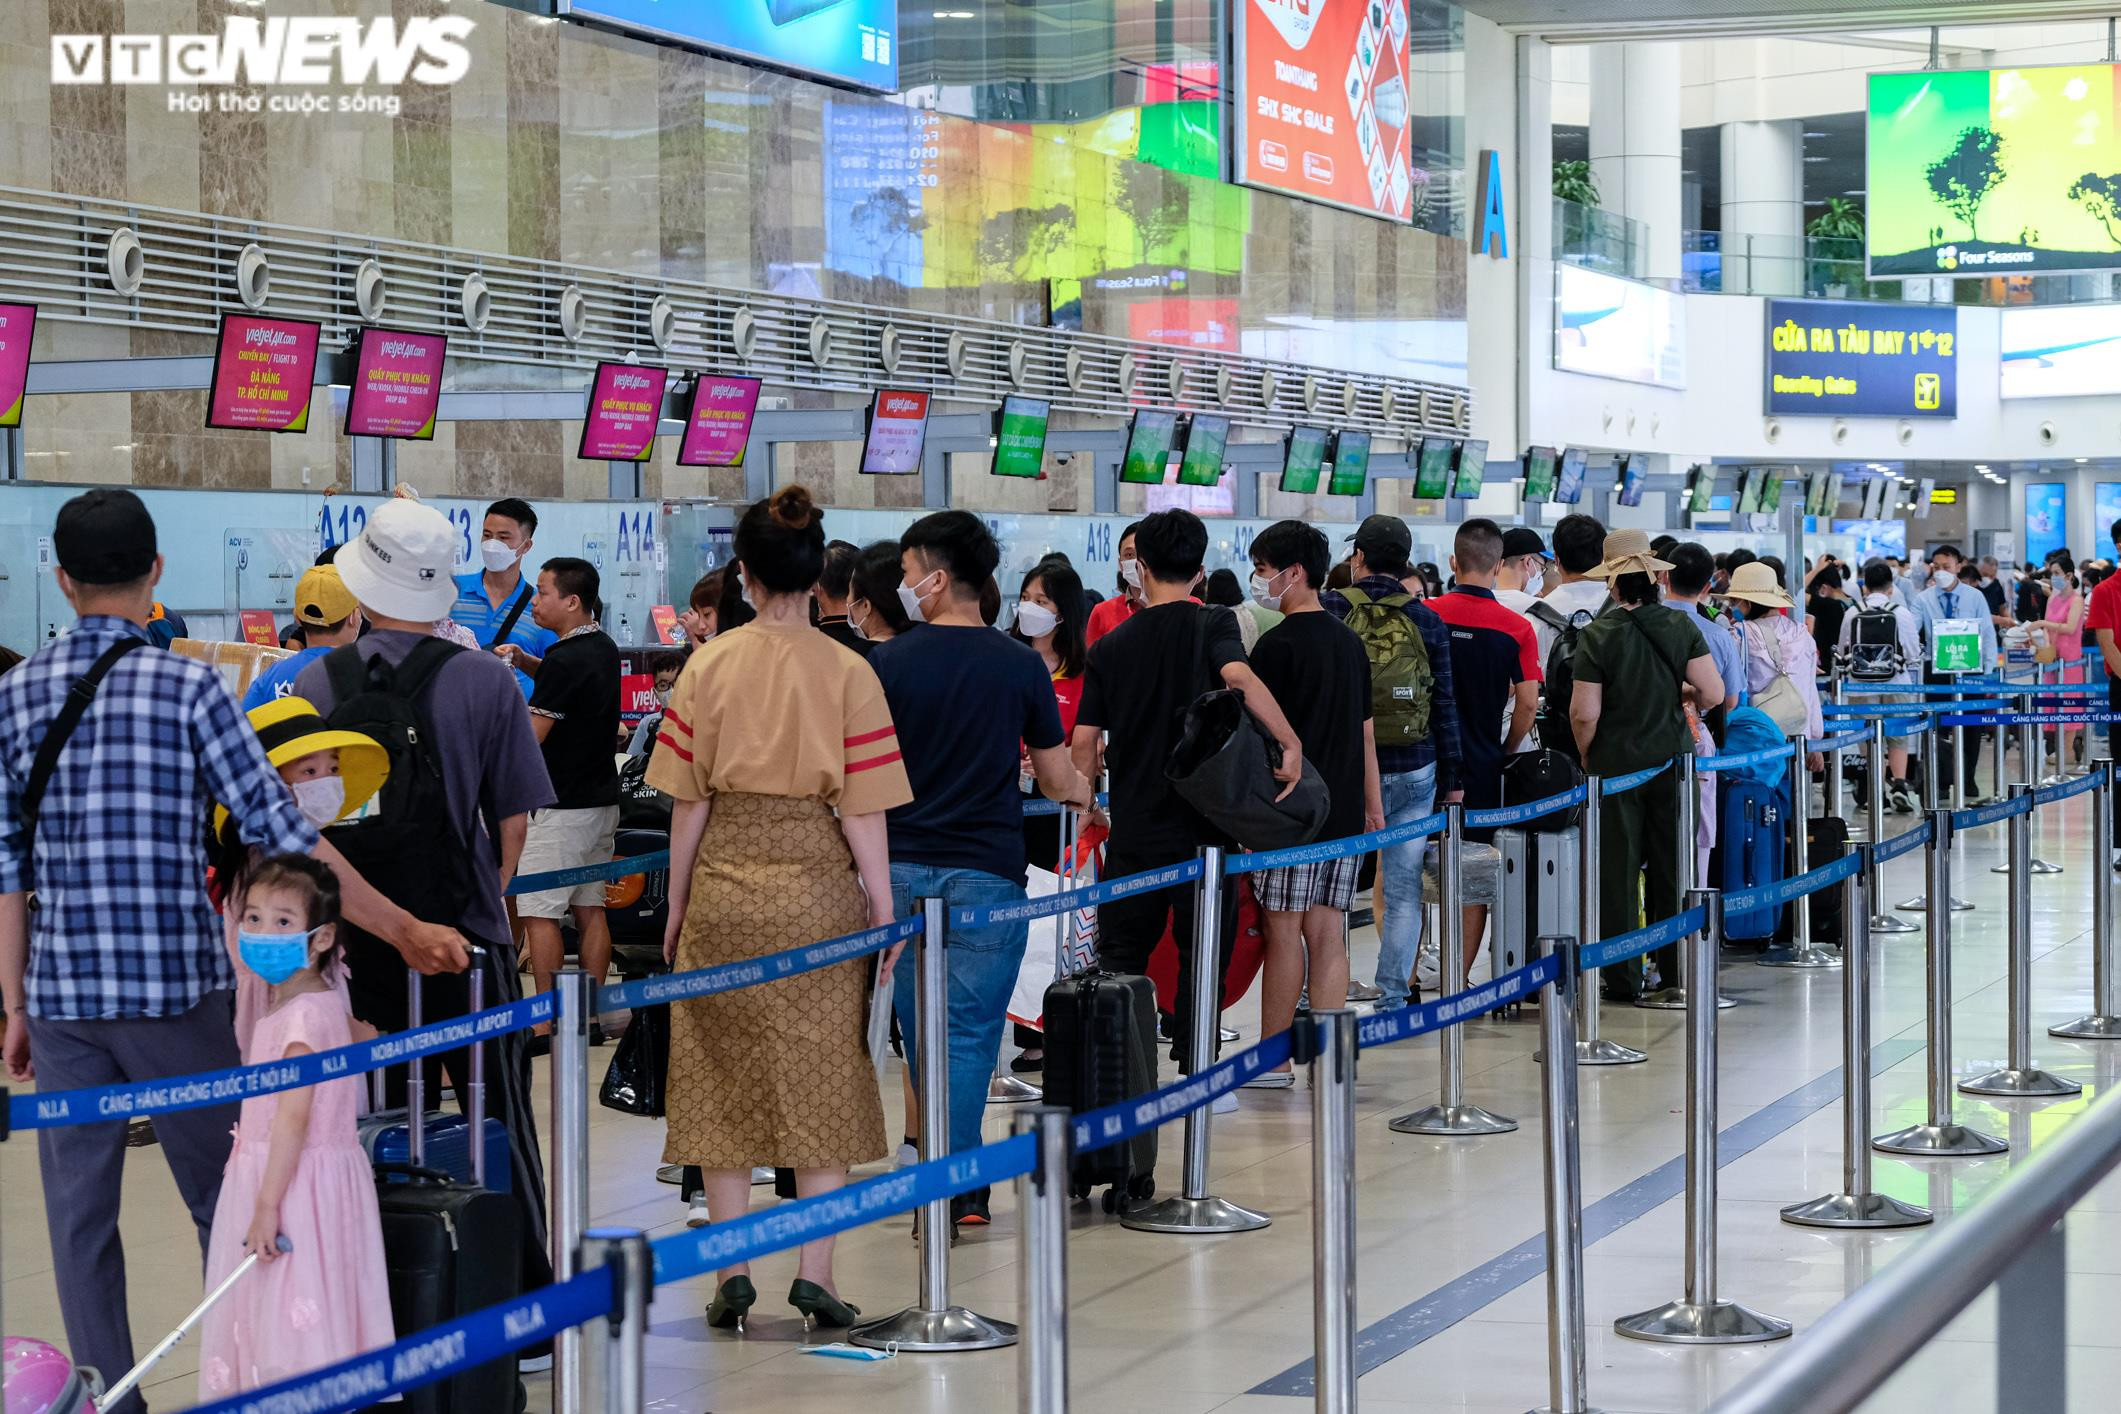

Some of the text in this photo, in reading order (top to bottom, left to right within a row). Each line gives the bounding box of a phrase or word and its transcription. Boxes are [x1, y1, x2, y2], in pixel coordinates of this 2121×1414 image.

[1477, 150, 1508, 258] A
[1959, 250, 2034, 265] Four Seasons
[1773, 319, 1807, 352] CỬA
[1811, 328, 1834, 352] RA
[1837, 323, 1870, 355] TÀU
[1873, 331, 1905, 354] BAY
[271, 389, 289, 401] MINH
[616, 511, 654, 561] A14
[1087, 523, 1110, 562] A18
[1981, 716, 1997, 724] N.I.A
[2049, 712, 2072, 722] KHÔNG
[2073, 712, 2091, 721] QUỐC
[633, 789, 658, 799] SKIN
[404, 1022, 475, 1052] INTERNATIONAL
[476, 1009, 513, 1036] AIRPORT
[531, 999, 551, 1018] N.I.A
[750, 1193, 859, 1244] INTERNATIONAL
[860, 1173, 918, 1218] AIRPORT
[391, 1329, 467, 1384] AIRPORT
